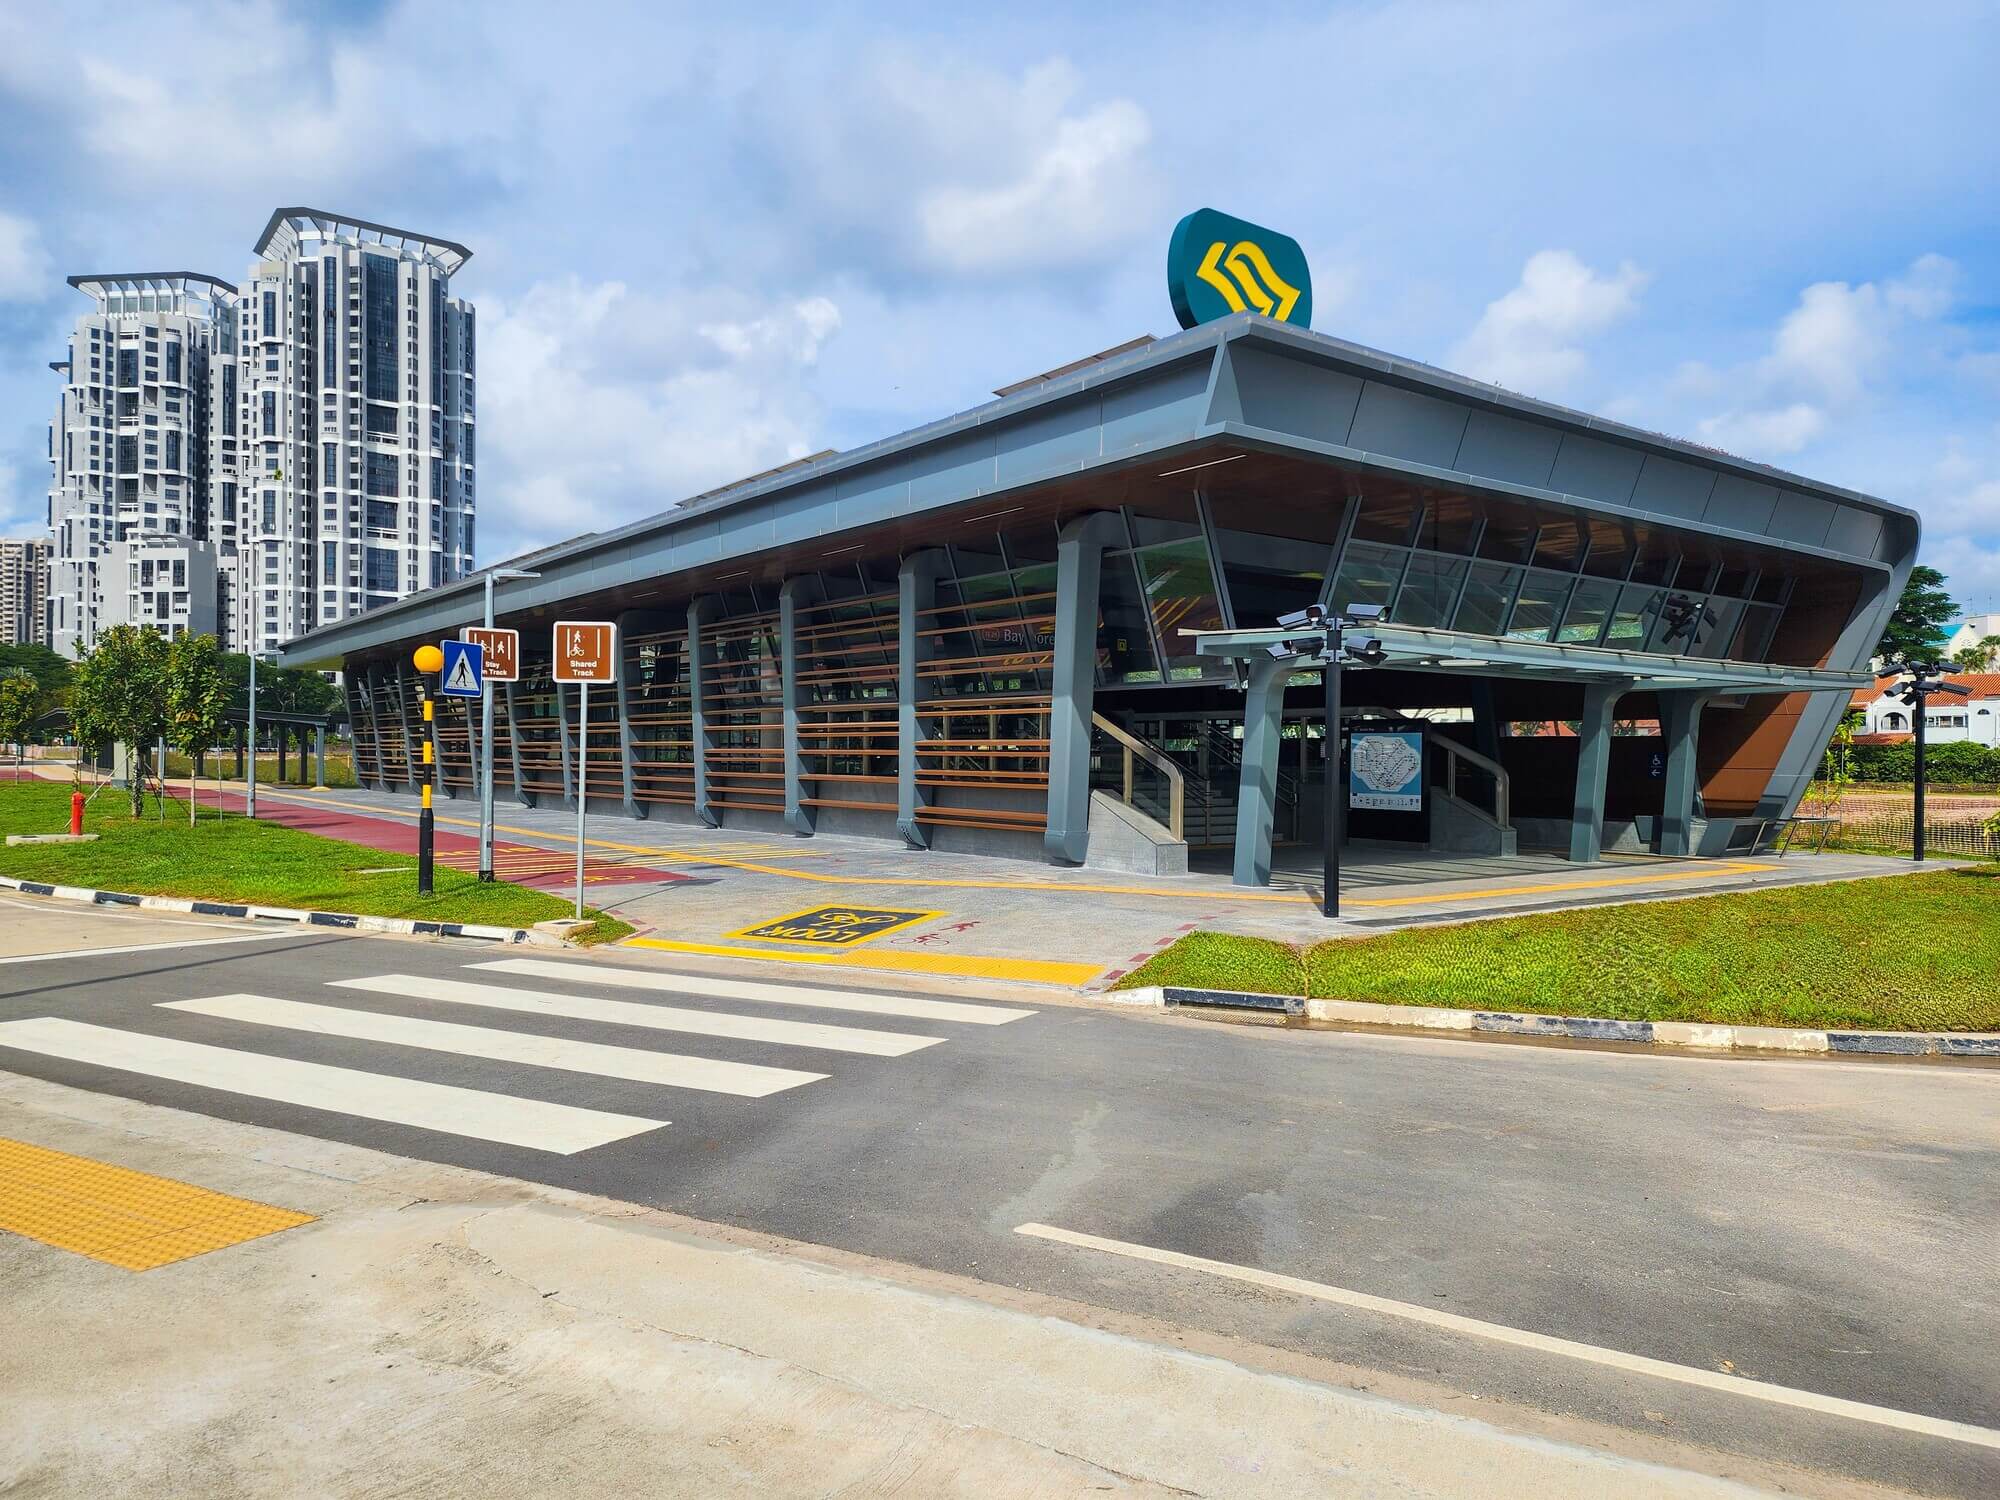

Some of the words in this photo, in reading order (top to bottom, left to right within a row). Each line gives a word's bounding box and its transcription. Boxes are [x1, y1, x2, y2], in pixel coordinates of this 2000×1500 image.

[1004, 629, 1056, 646] Bayore
[485, 660, 500, 669] Stay
[570, 660, 597, 668] Shared
[488, 668, 508, 676] Track
[572, 669, 594, 677] Track
